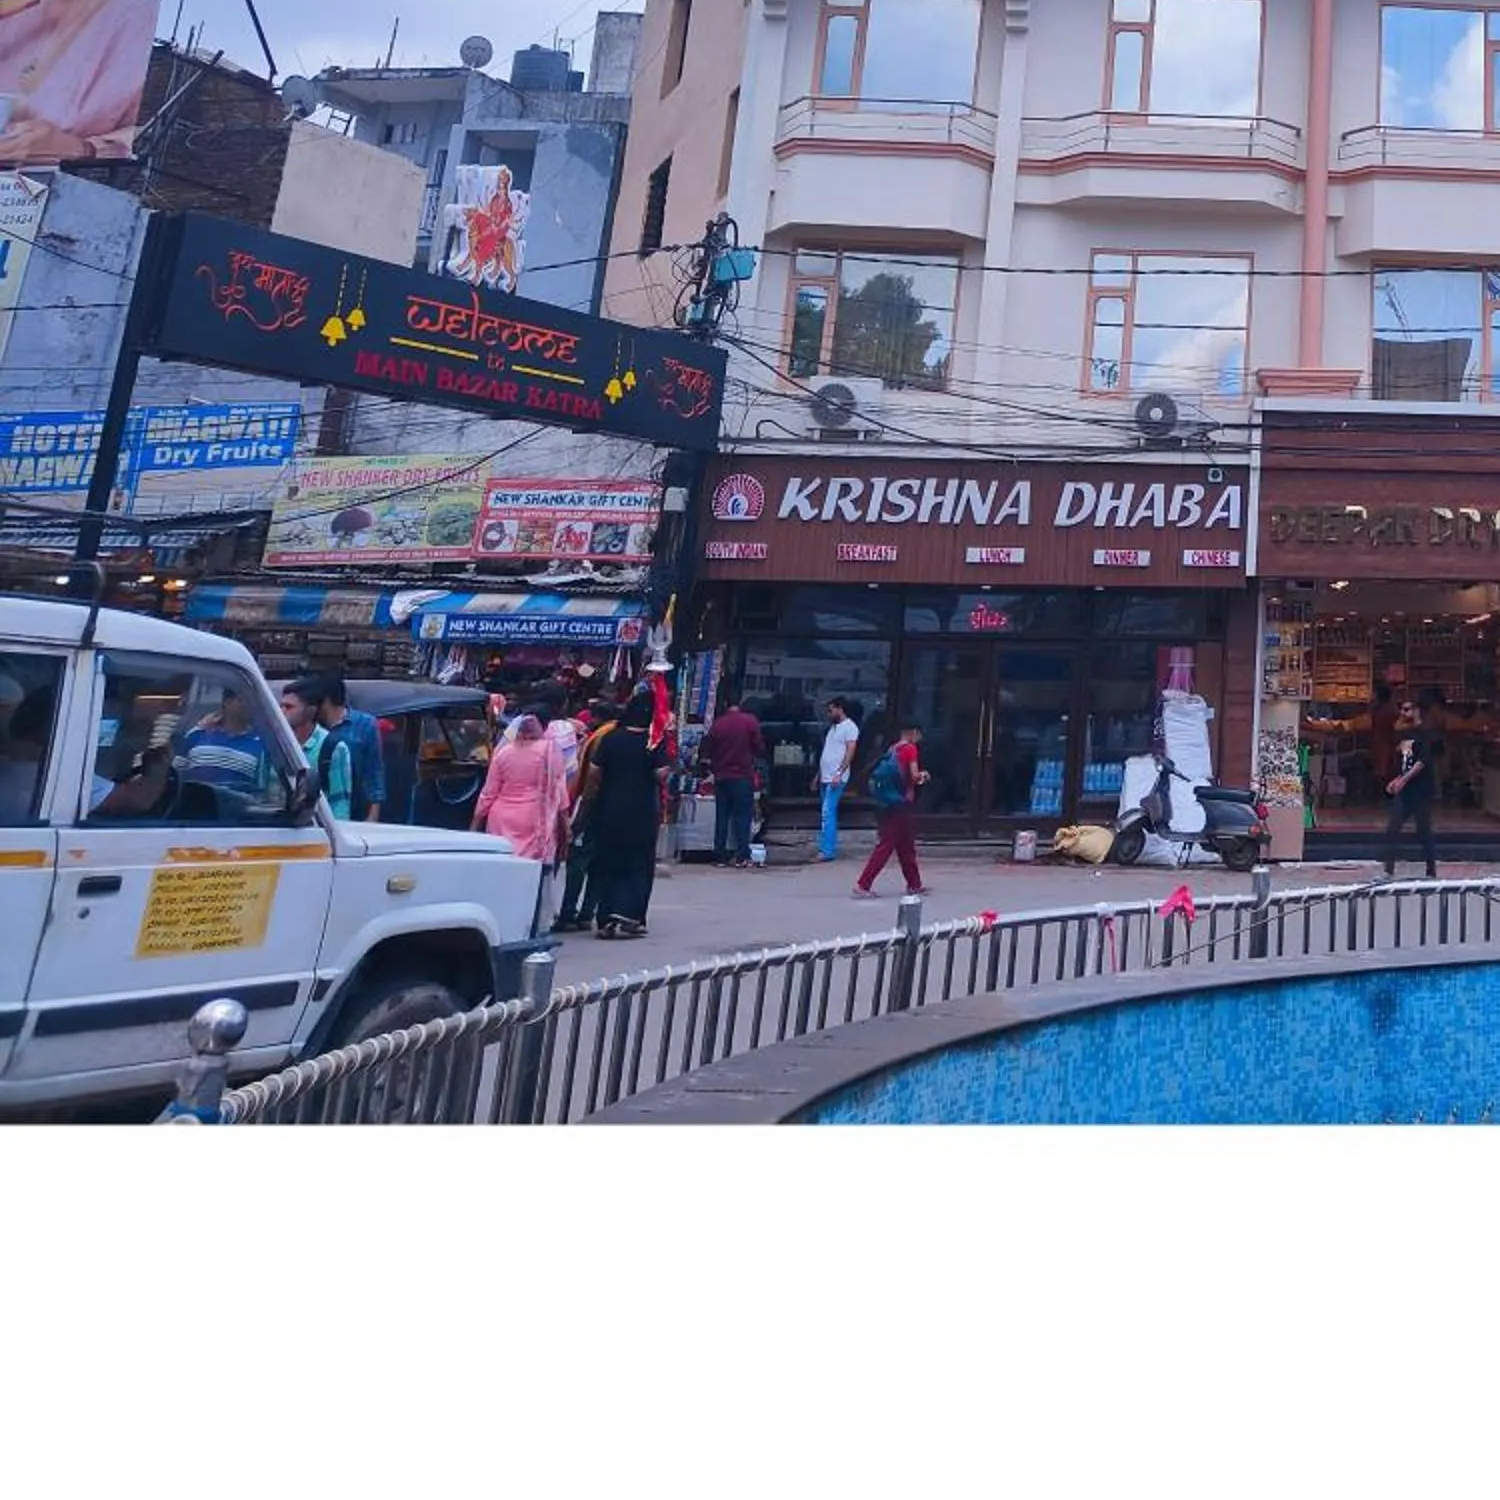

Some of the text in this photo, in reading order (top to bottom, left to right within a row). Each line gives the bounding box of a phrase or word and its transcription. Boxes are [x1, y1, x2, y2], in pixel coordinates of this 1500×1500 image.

[355, 351, 602, 419] MAIN BAZAR KATRA
[154, 442, 284, 466] Dry Fruits
[301, 471, 333, 489] NEW
[494, 492, 521, 506] NEW
[524, 493, 585, 508] SHANKAR
[589, 495, 616, 508] GIFT
[776, 476, 1243, 530] KRISHNA DHABA
[837, 544, 898, 561] BREAKFAST
[1191, 551, 1232, 566] CHINESE
[449, 619, 477, 631] NEW
[478, 620, 537, 633] SHANKAR
[540, 621, 568, 633] GIFT
[569, 622, 613, 635] CENTRE
